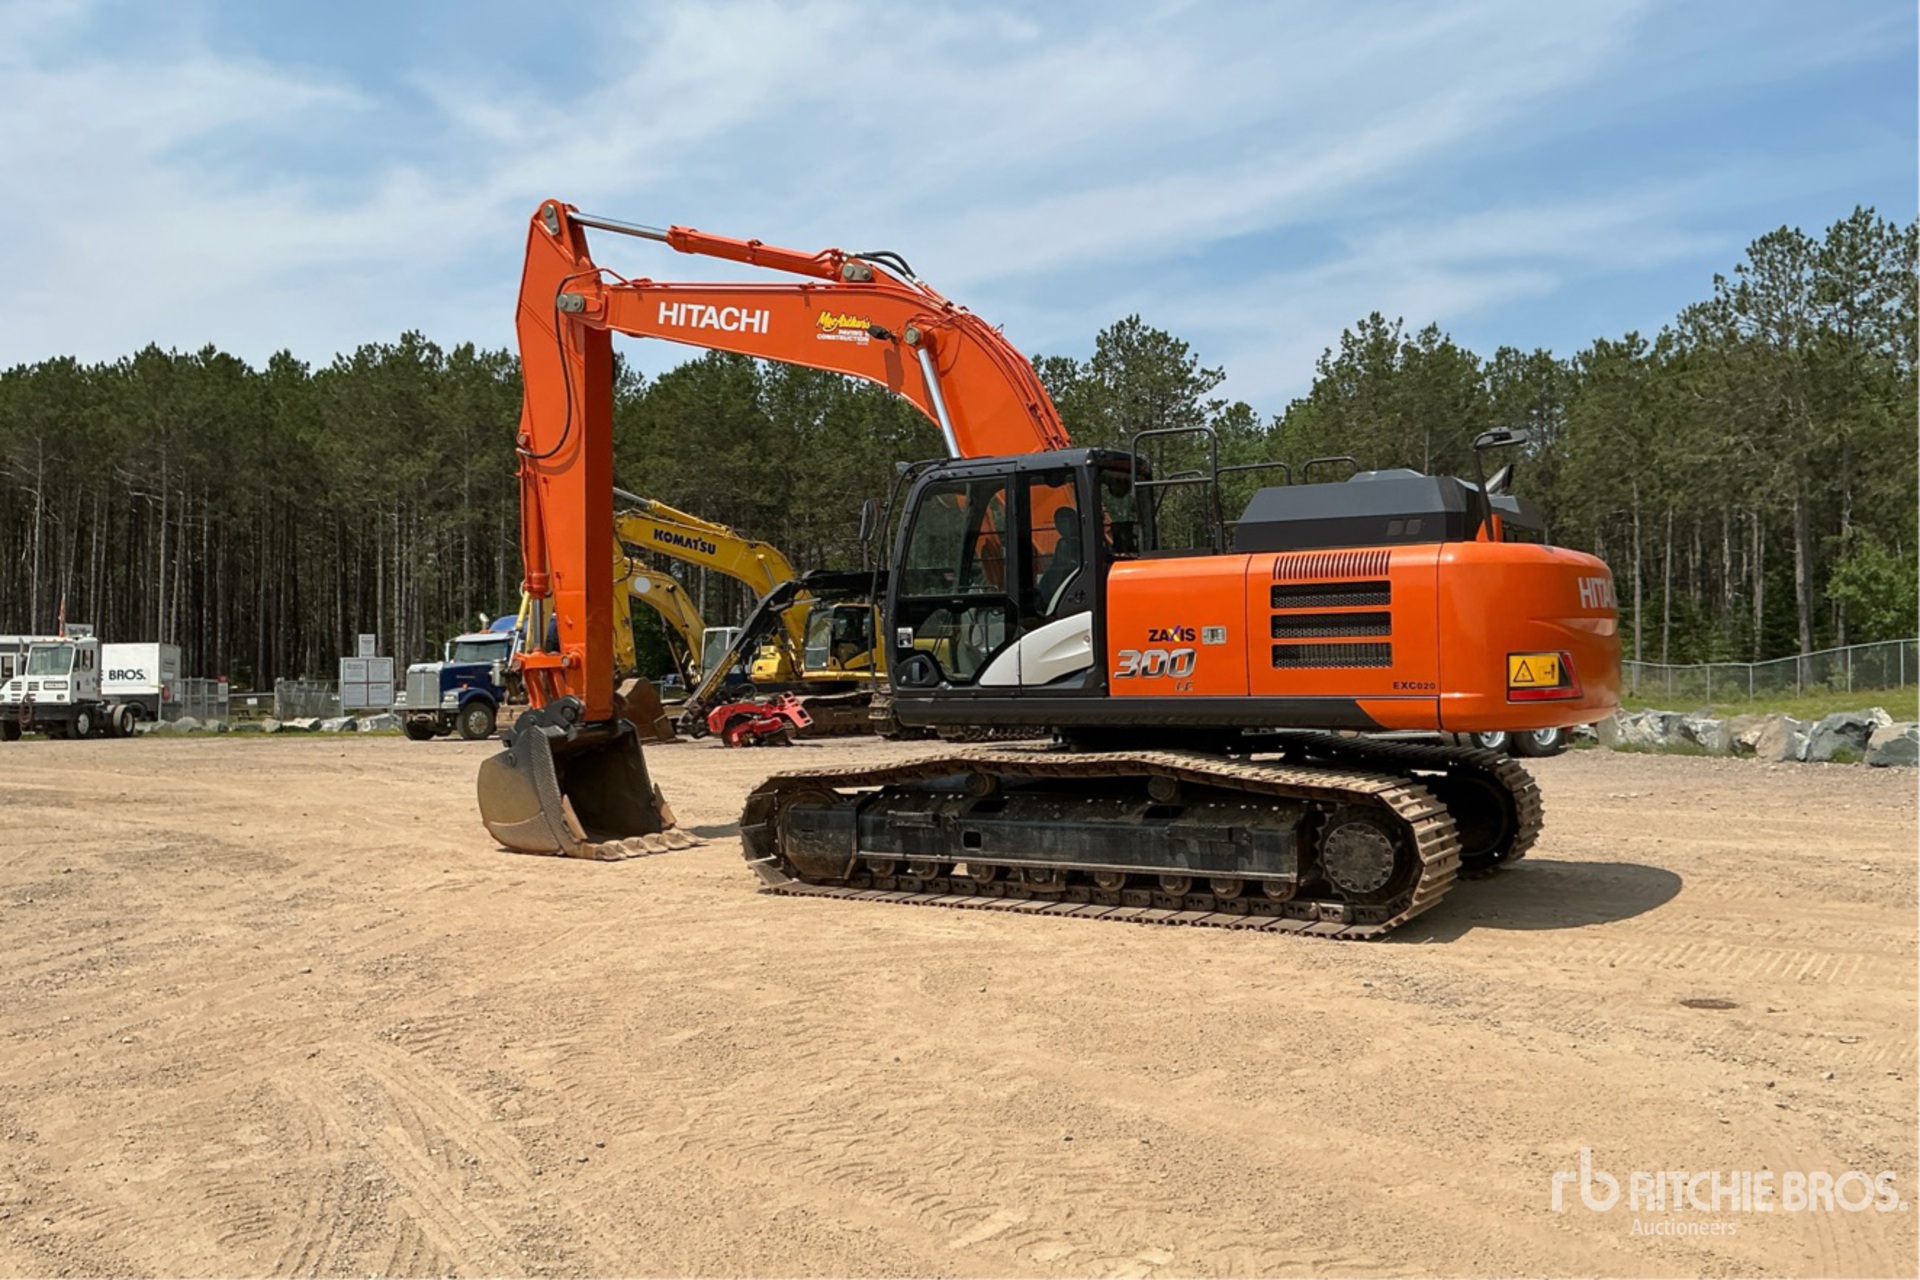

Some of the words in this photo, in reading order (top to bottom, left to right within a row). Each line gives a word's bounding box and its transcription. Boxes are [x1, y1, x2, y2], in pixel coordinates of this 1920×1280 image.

[658, 301, 770, 334] HITACHI
[816, 333, 870, 342] CONSTRUCTION
[653, 528, 717, 555] KOMATSU
[1577, 576, 1617, 609] HITA
[1148, 625, 1196, 642] ZAXIS
[1113, 648, 1197, 678] 300
[108, 668, 147, 681] BROS.
[1392, 680, 1436, 690] EXC020
